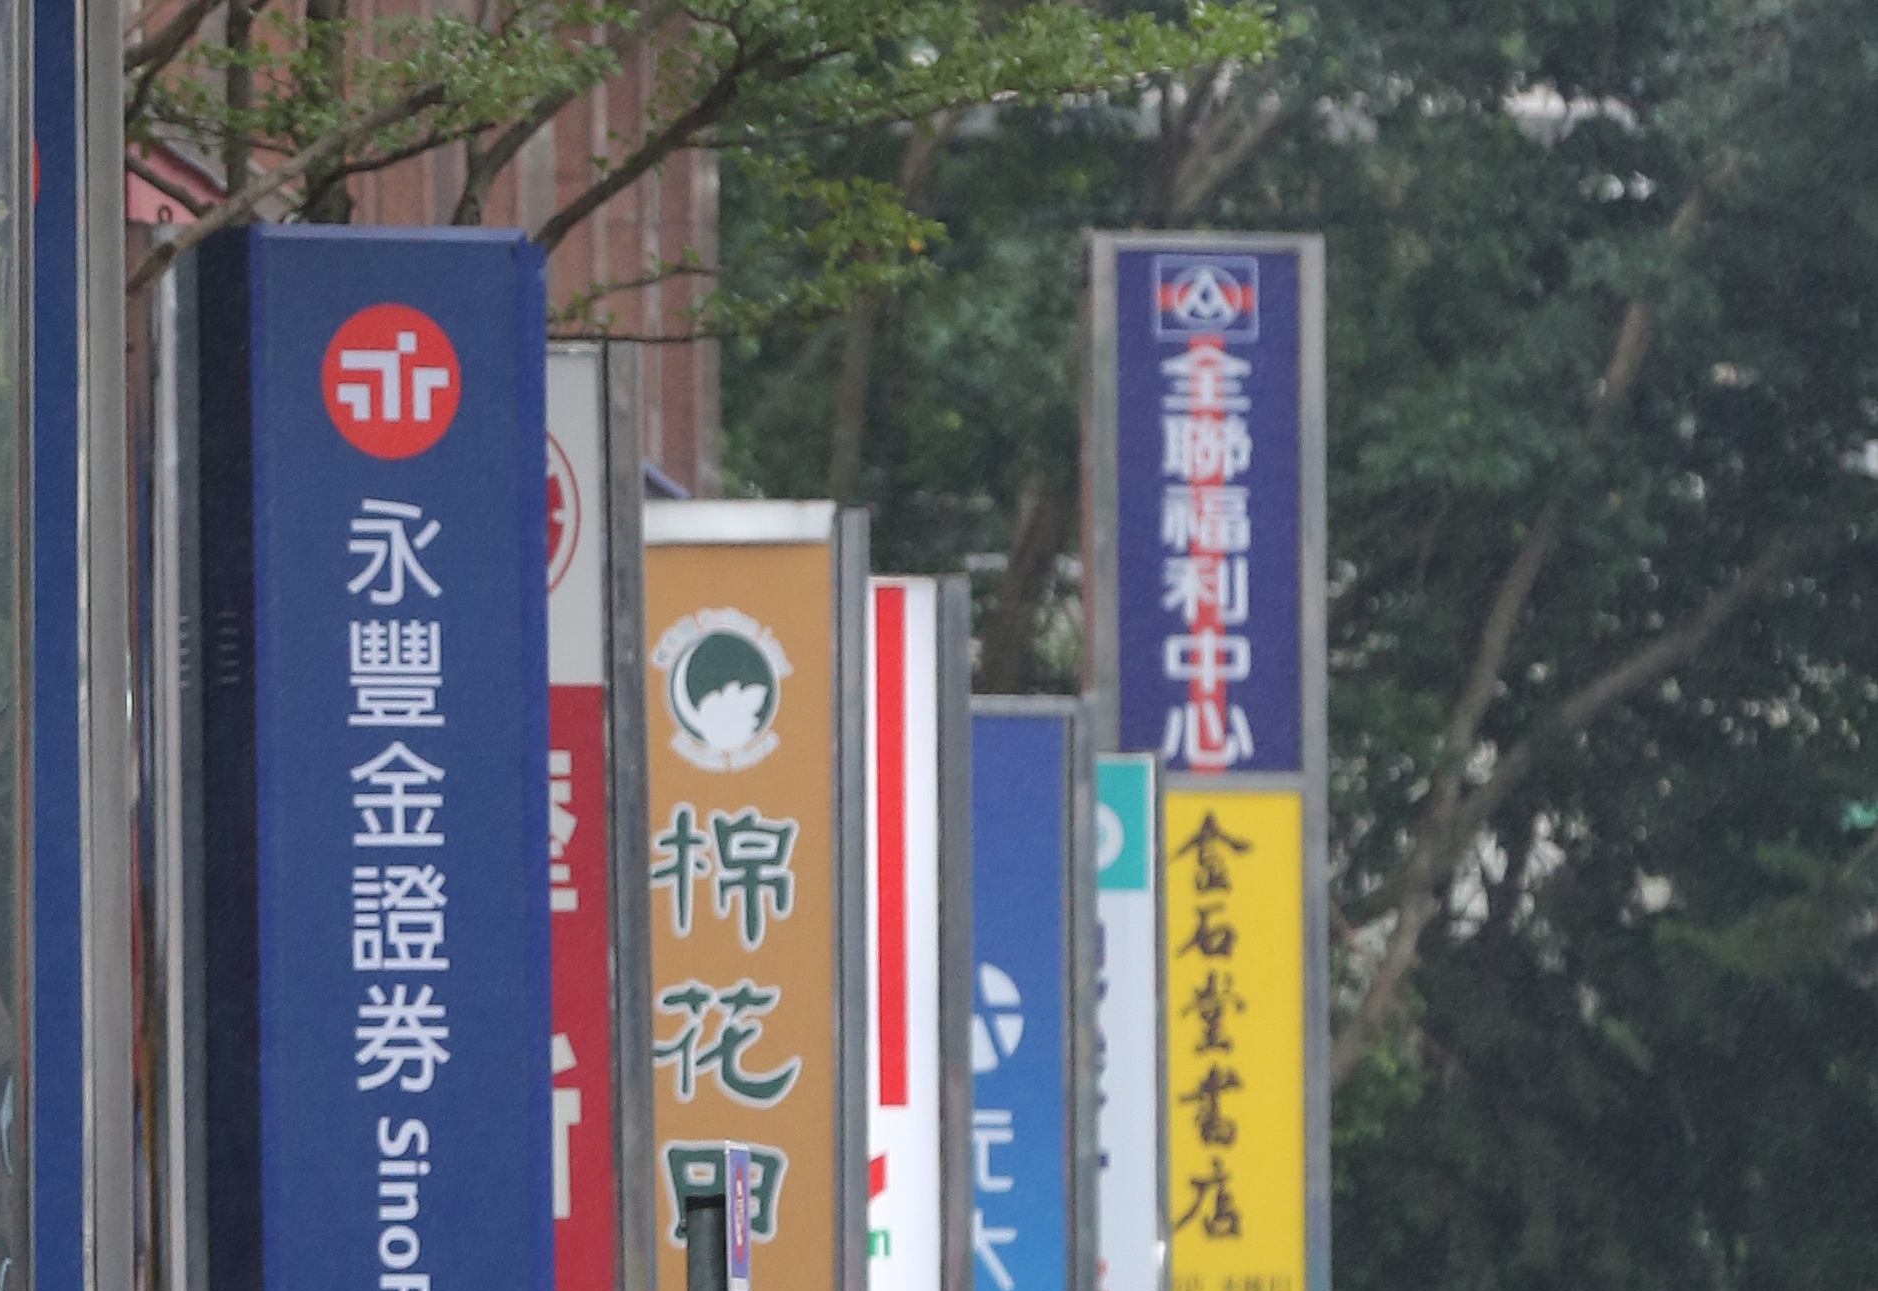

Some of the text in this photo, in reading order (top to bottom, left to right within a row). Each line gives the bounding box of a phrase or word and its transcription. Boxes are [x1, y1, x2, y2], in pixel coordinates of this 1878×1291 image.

[1159, 343, 1254, 766] 全聯福利中心
[346, 498, 451, 1093] 永豐金證券
[1168, 808, 1255, 1241] 金石堂書店
